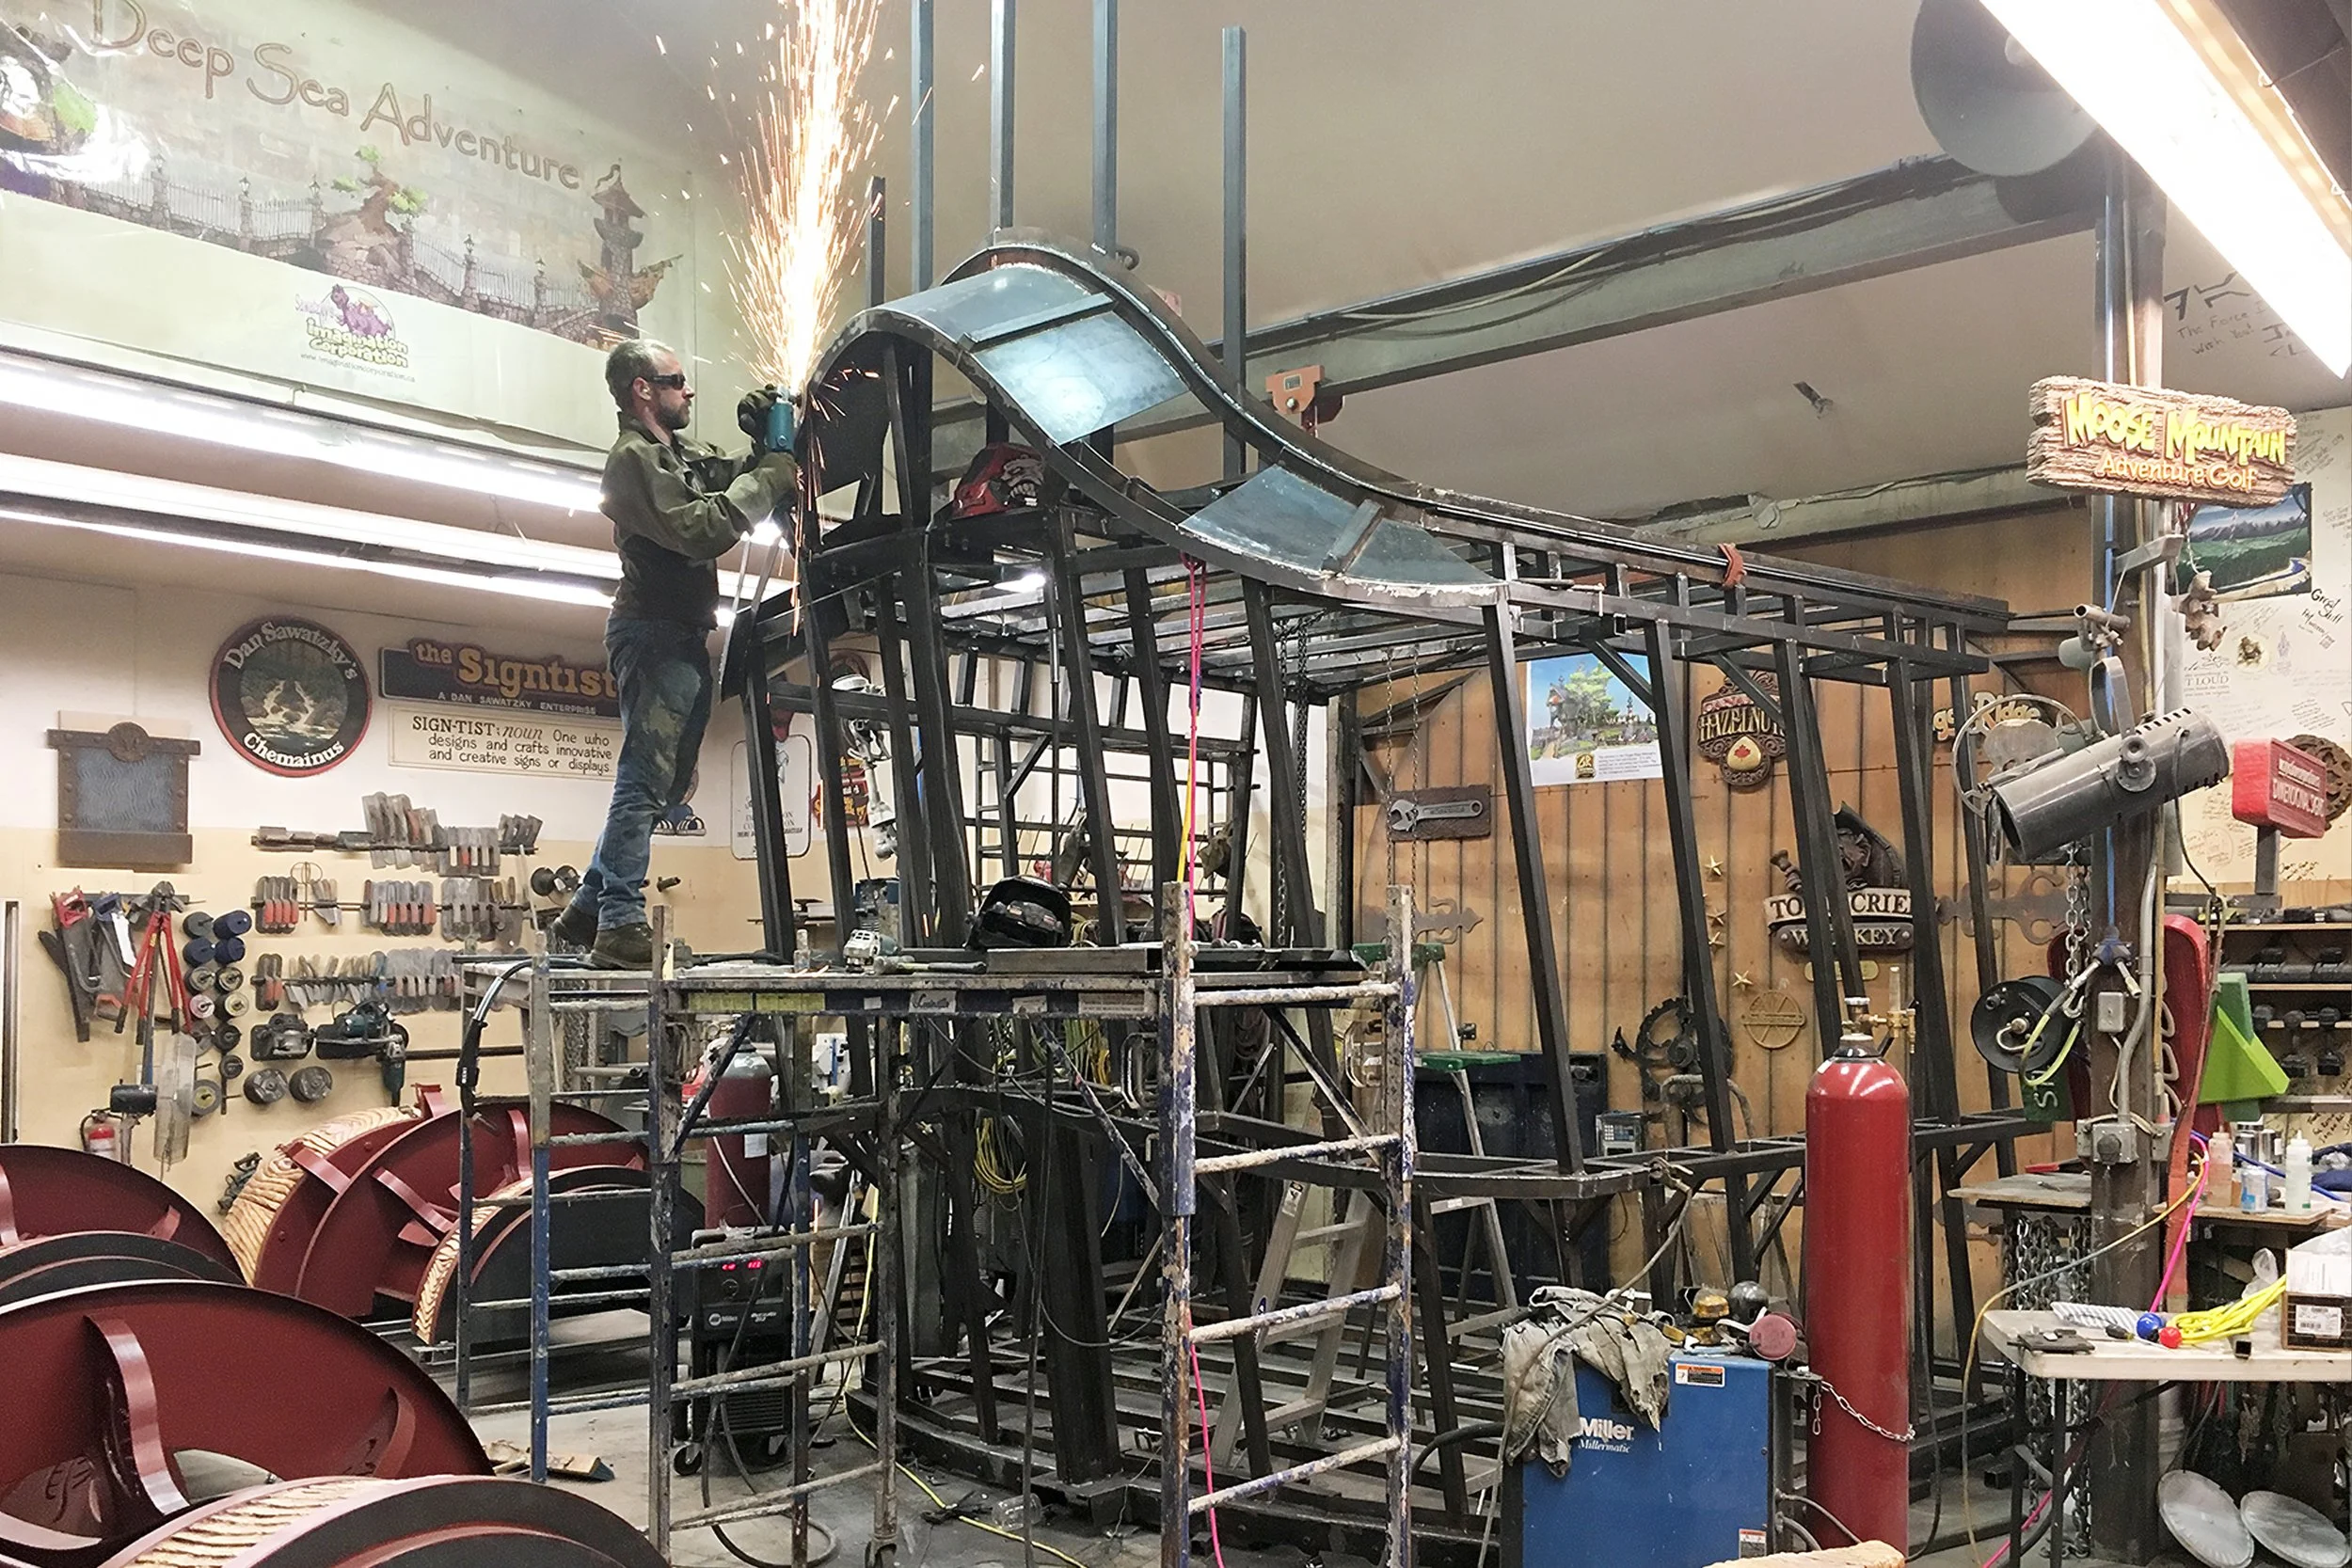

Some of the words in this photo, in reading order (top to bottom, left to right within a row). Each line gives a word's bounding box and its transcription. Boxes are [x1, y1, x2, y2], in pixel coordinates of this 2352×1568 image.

[90, 0, 234, 99] Deep
[246, 43, 349, 117] Sea
[360, 83, 580, 190] Adventure
[2096, 452, 2206, 483] Adventure
[2208, 464, 2259, 492] Golf
[224, 634, 266, 670] Dan
[261, 621, 358, 680] Sawatzky's
[415, 641, 453, 665] the
[437, 691, 446, 700] A
[451, 693, 472, 704] DAN
[480, 695, 532, 709] SAWATZKY
[539, 701, 596, 715] ENTERPRISE
[428, 733, 477, 752] designs
[486, 738, 508, 752] and
[515, 741, 550, 755] crafts
[556, 743, 613, 760] innovative
[502, 725, 543, 741] noun
[553, 728, 578, 744] One
[584, 733, 610, 746] who
[243, 731, 346, 768] Chemainus
[429, 748, 452, 761] and
[459, 751, 507, 766] creative
[514, 753, 542, 770] signs
[548, 758, 561, 769] or
[568, 757, 611, 776] displays
[1851, 893, 1912, 915] CRIE
[1579, 1416, 1635, 1443] Miller
[1578, 1438, 1632, 1454] Millermatic
